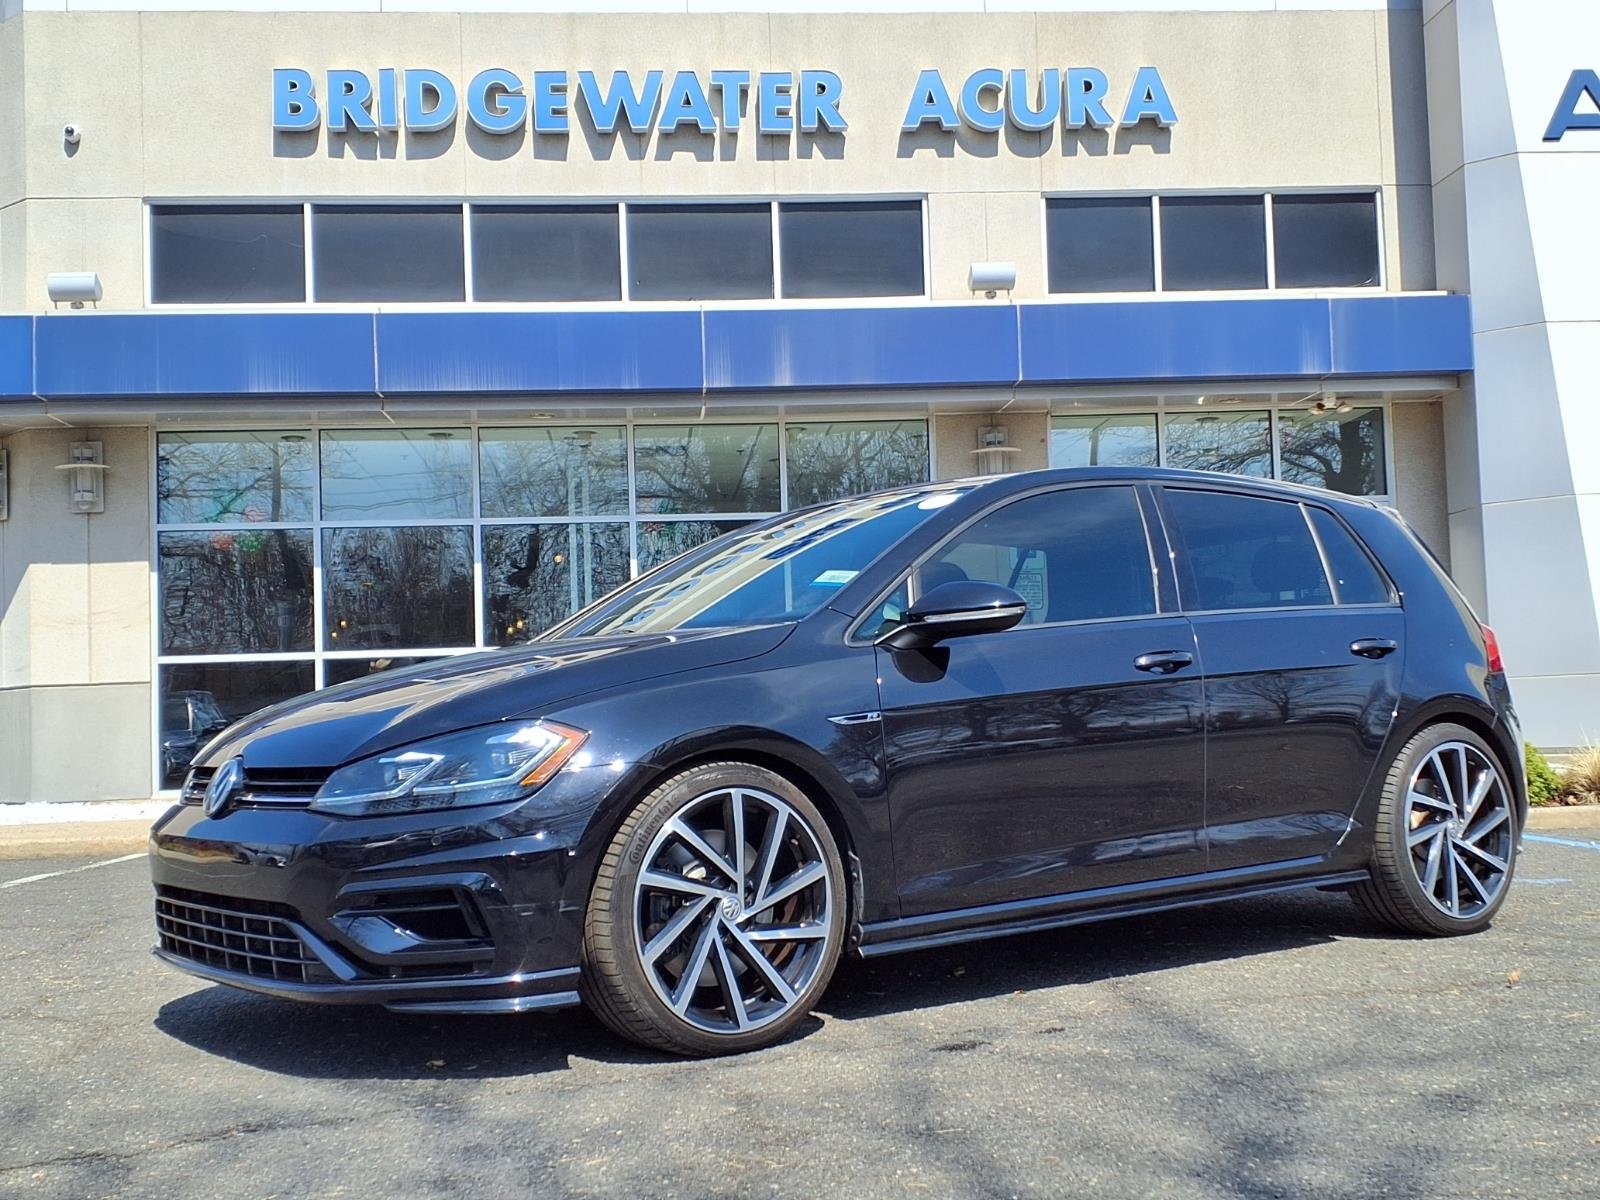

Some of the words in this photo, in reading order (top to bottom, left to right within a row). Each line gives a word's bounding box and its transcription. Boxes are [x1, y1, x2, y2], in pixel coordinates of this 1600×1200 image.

[272, 67, 846, 135] BRIDGEWATER
[900, 66, 1178, 132] ACURA
[628, 802, 674, 865] Continental
